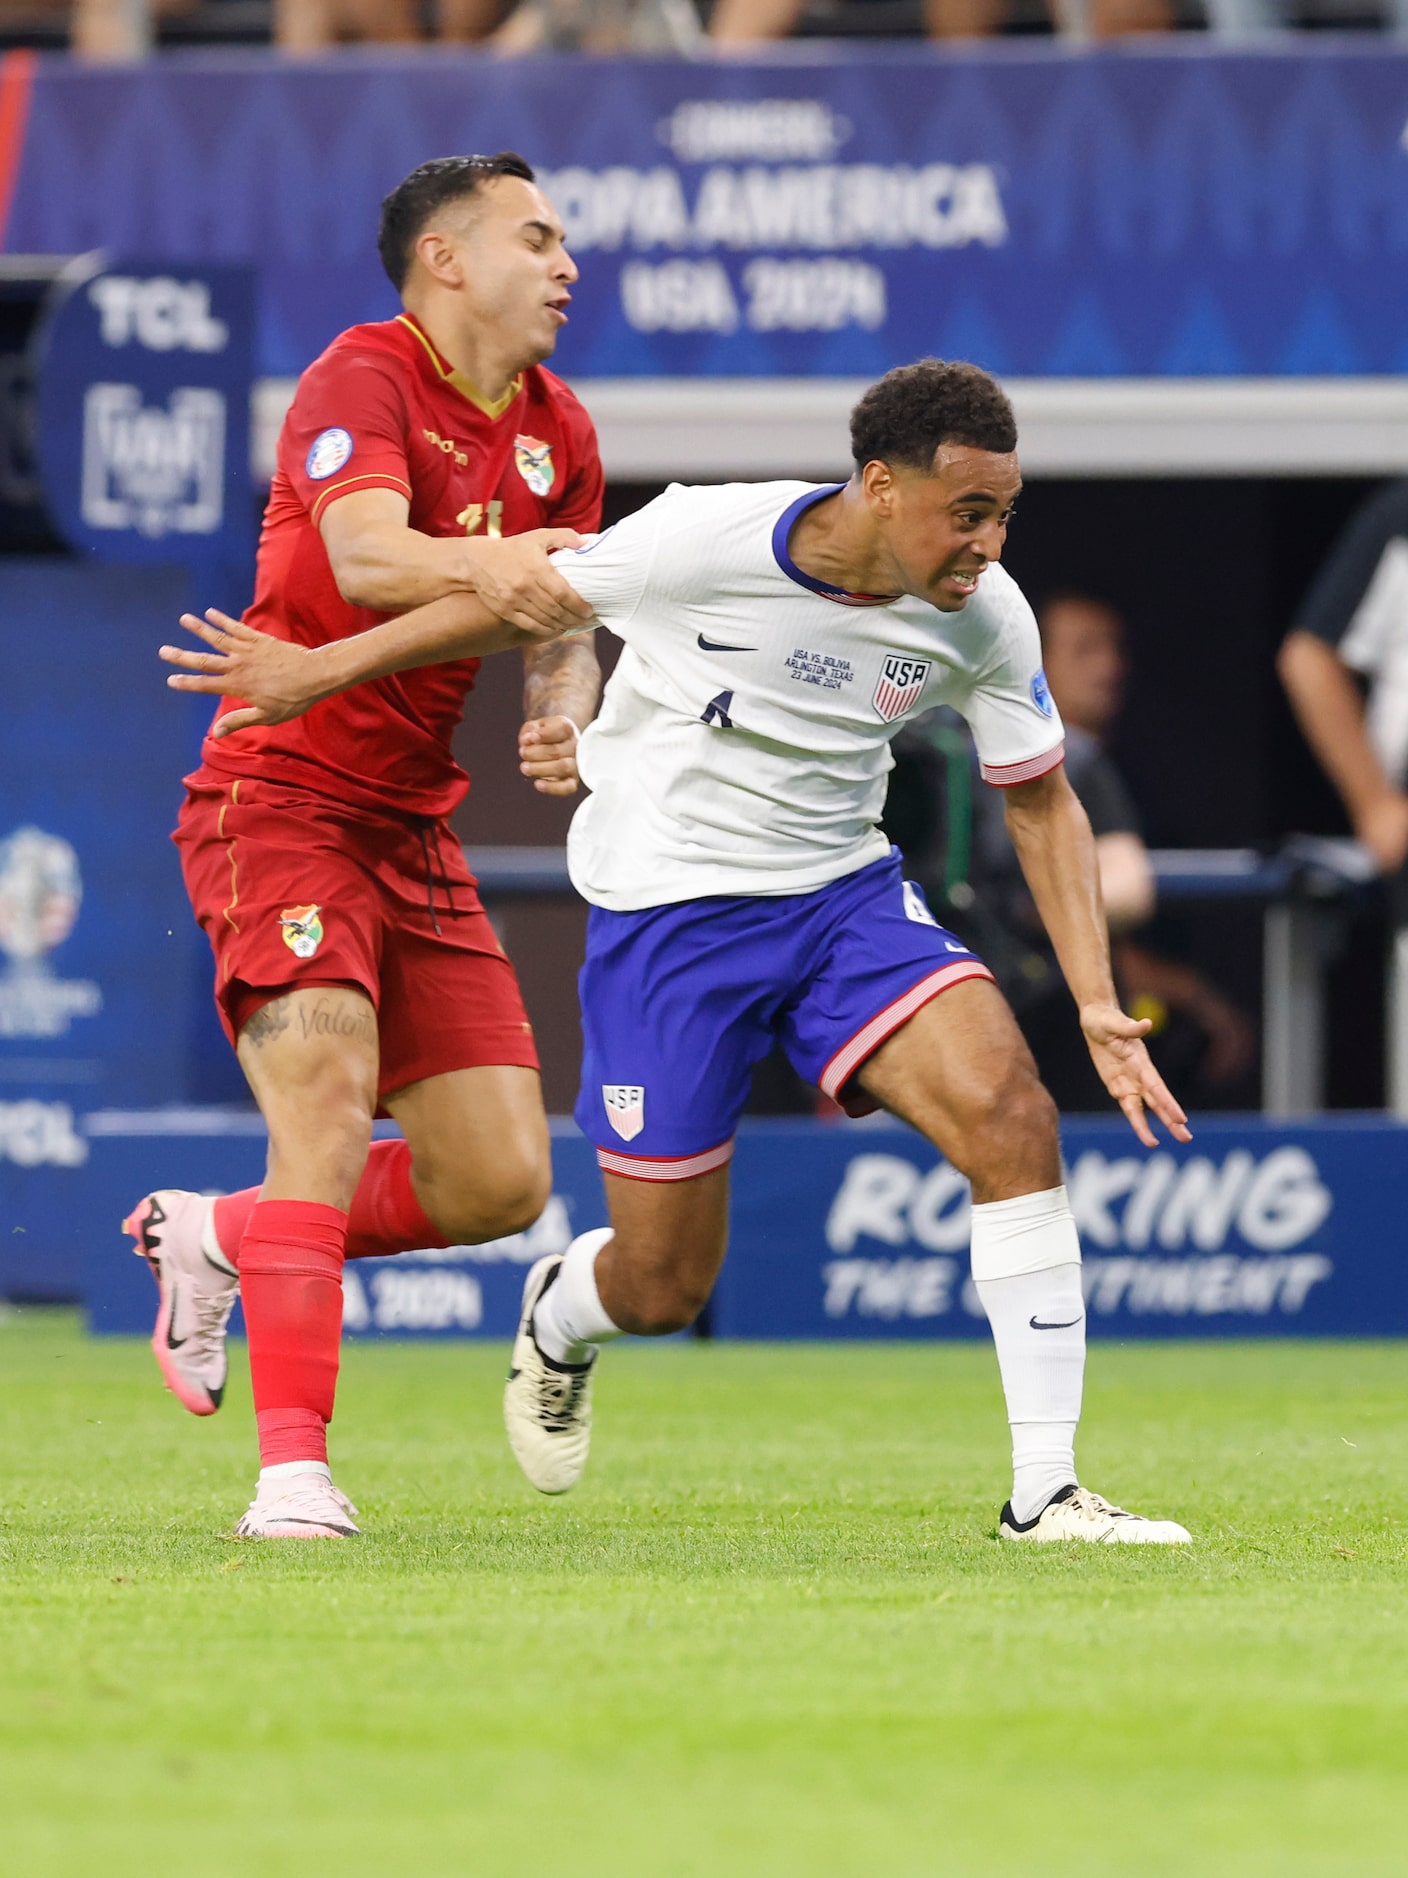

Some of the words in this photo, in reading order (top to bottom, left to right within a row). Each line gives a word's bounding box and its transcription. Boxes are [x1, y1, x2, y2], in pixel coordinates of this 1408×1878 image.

[89, 275, 229, 352] TCL
[620, 257, 739, 333] USA
[743, 256, 886, 332] 2024
[791, 670, 802, 680] 23
[802, 673, 823, 685] JUNE
[823, 677, 842, 690] 2024
[793, 648, 808, 660] USA
[823, 657, 850, 670] BOLIVIA
[831, 668, 855, 682] TEXAS
[885, 659, 927, 688] USA
[827, 1148, 1332, 1252] ROKING
[822, 1255, 957, 1319] THE
